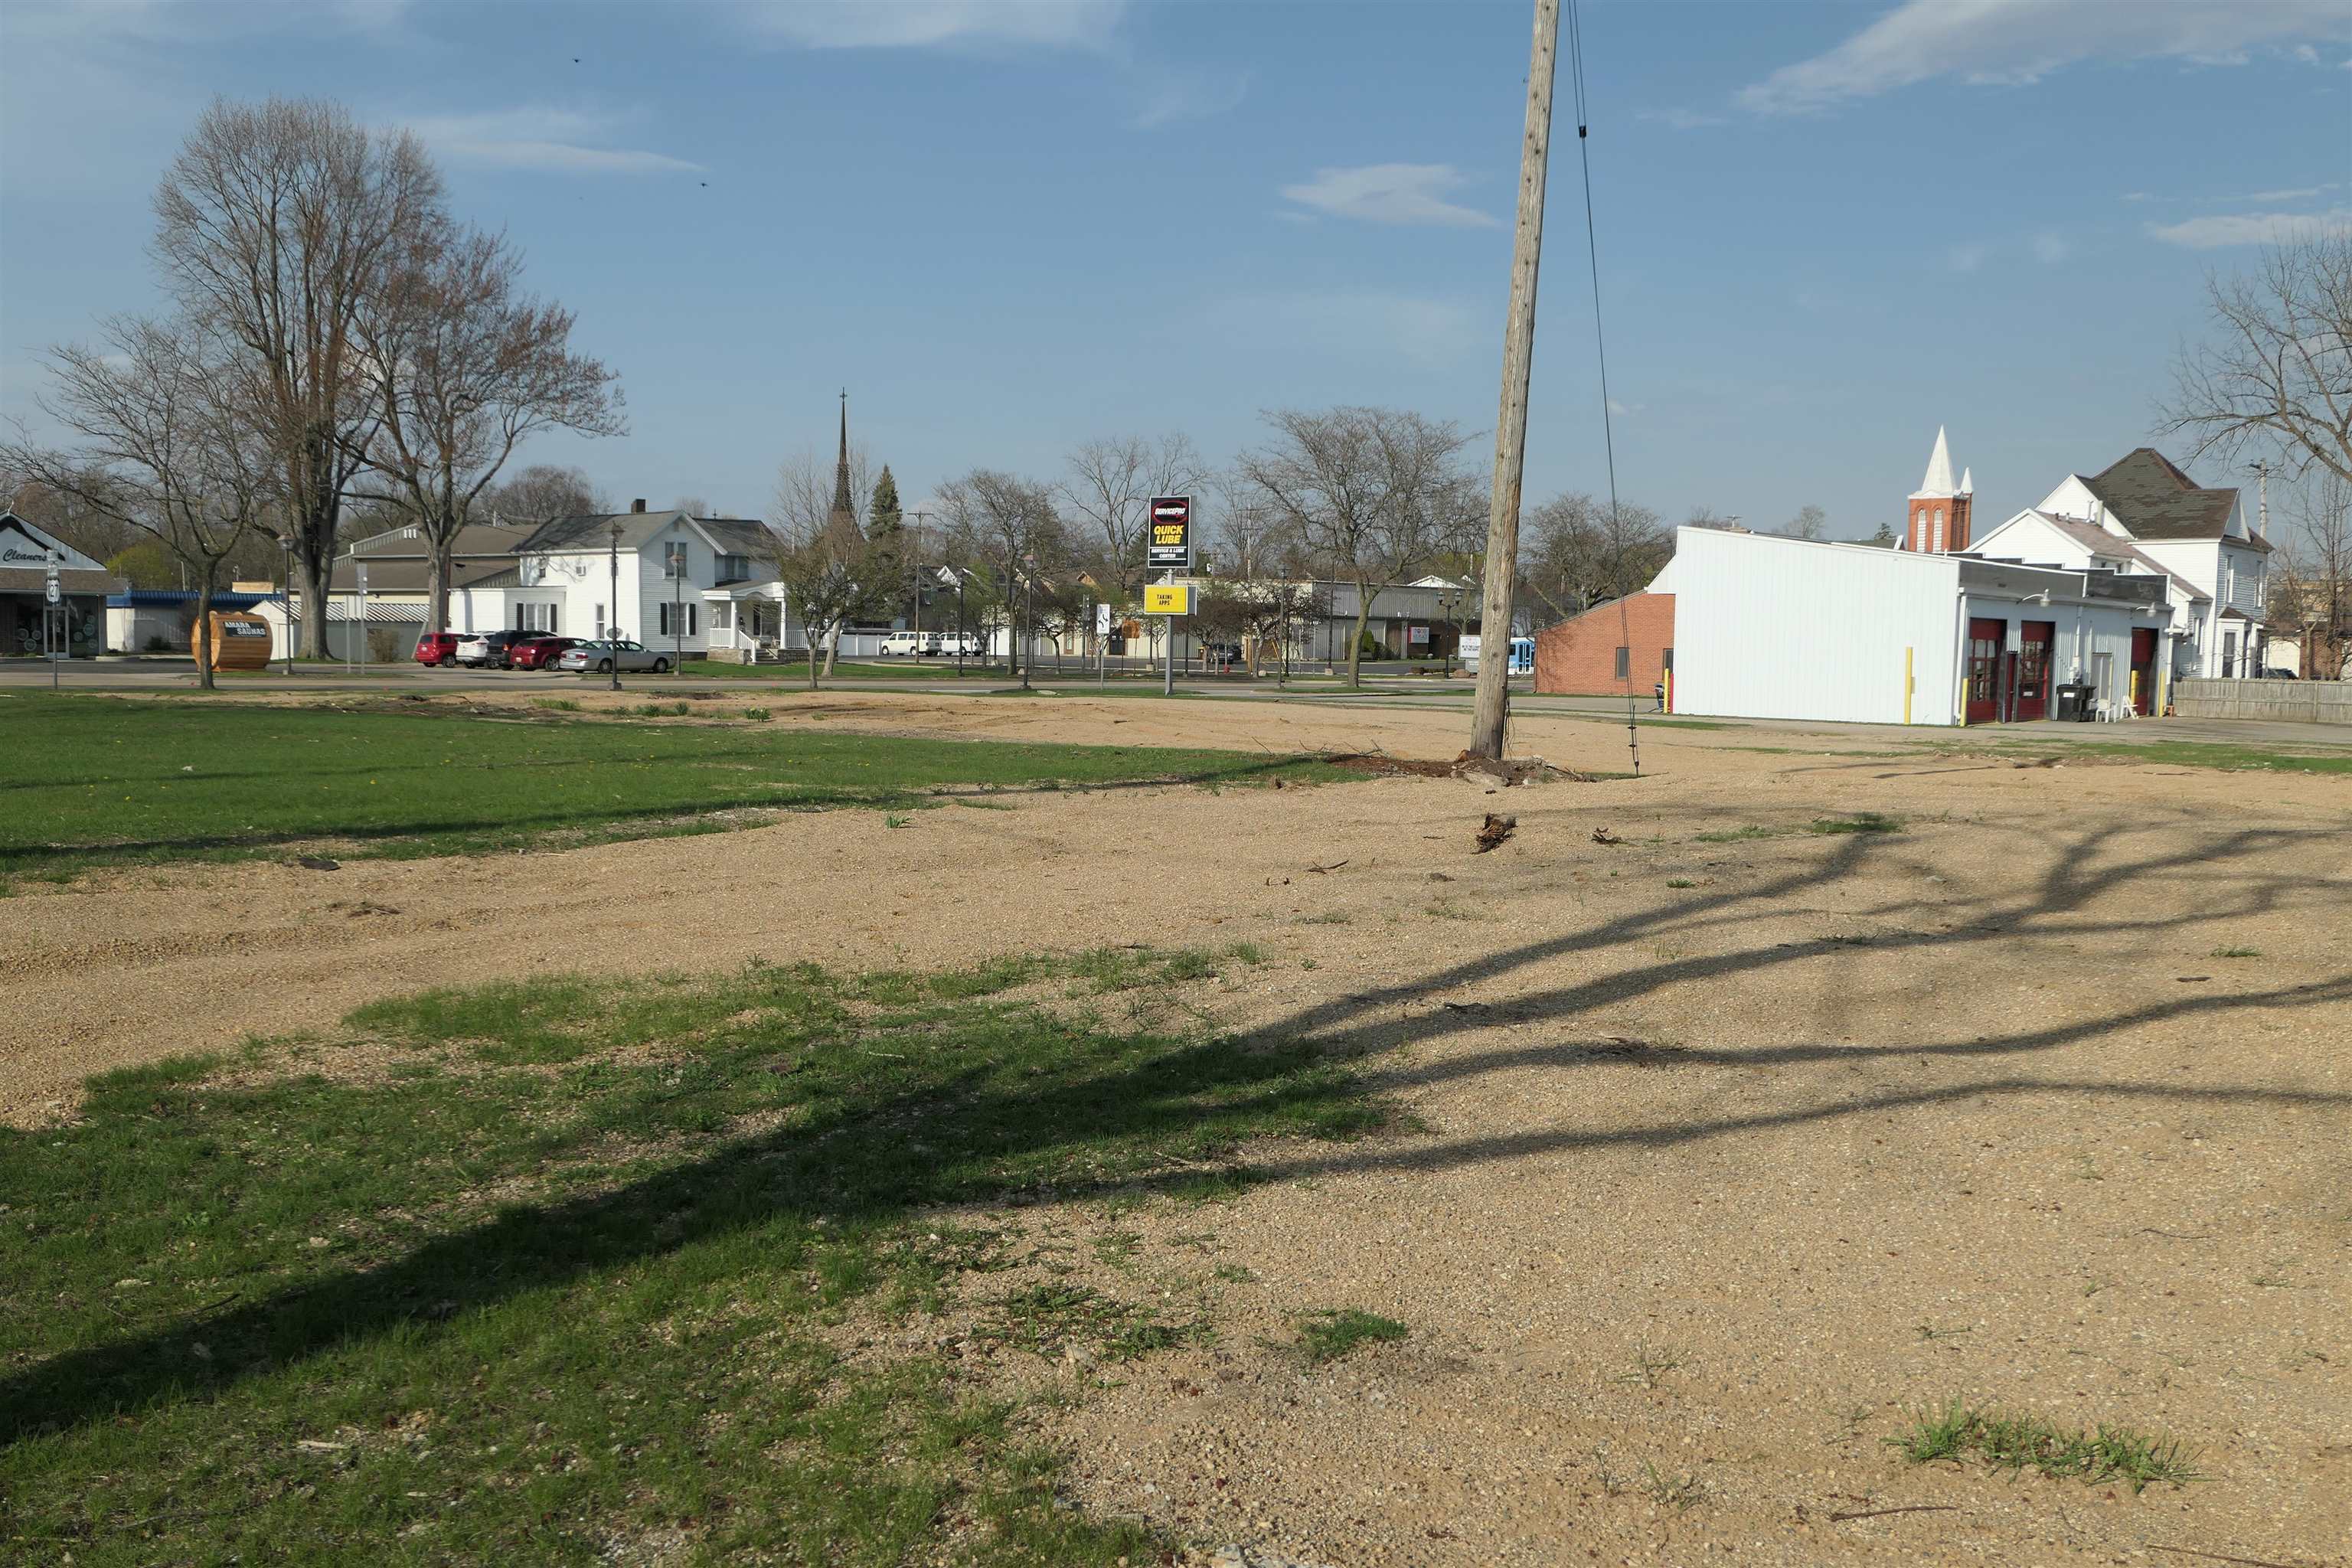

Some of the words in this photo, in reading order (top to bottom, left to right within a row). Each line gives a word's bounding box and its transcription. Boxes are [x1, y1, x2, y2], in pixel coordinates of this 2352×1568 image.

[1154, 525, 1184, 534] QUICK
[1155, 534, 1181, 544] LUBE
[2, 549, 47, 562] Cleaners
[48, 584, 58, 597] 127
